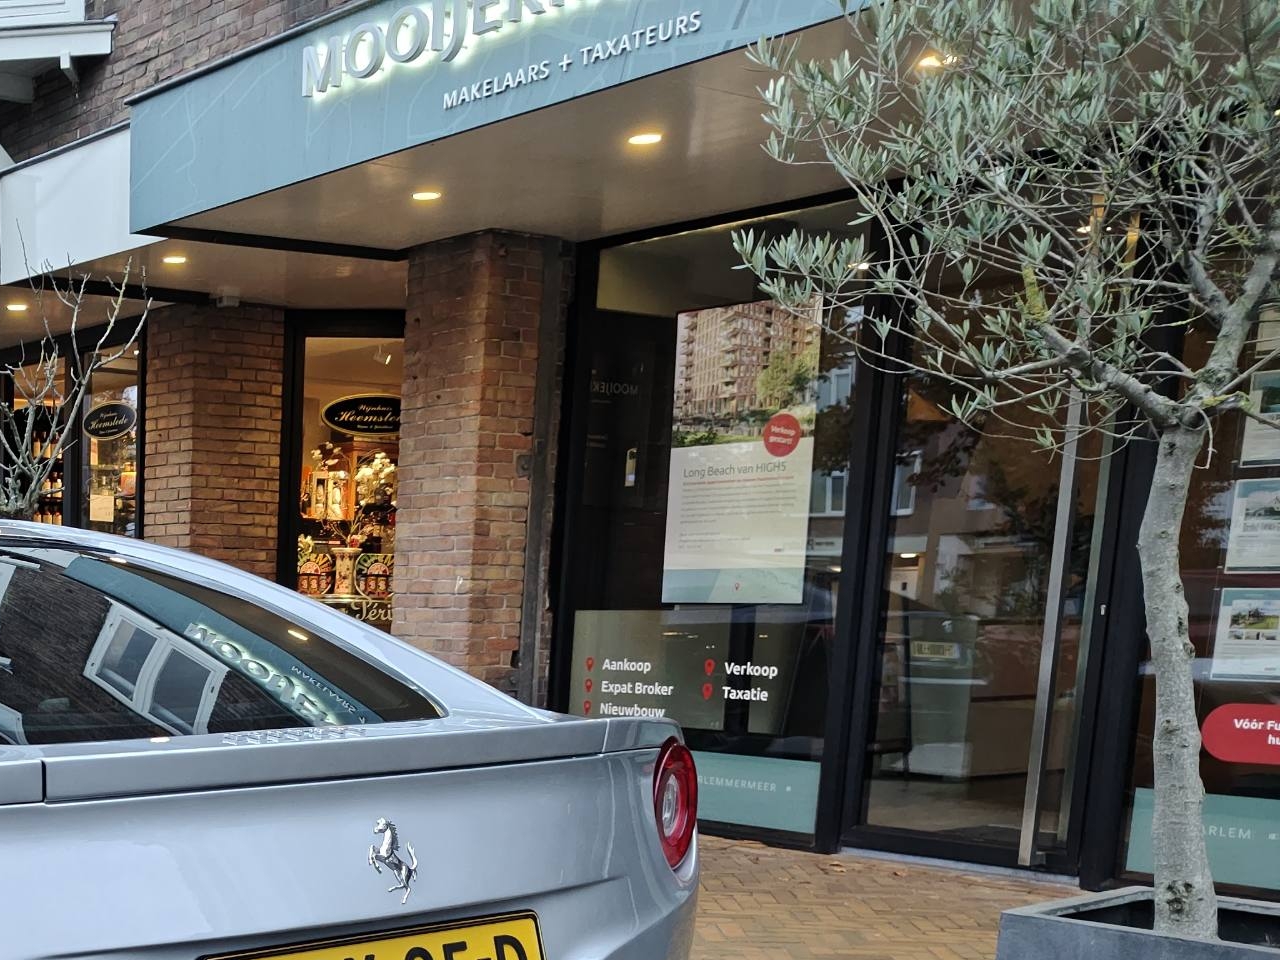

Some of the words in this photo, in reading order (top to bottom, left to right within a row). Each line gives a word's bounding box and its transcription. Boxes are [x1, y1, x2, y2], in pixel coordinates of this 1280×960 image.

[301, 0, 566, 97] MOOIJE
[442, 60, 550, 110] MAKELAARS
[558, 54, 574, 73] +
[579, 11, 703, 66] TAXATEURS
[683, 468, 706, 480] Long
[707, 464, 736, 477] Beach
[737, 466, 754, 475] van
[602, 658, 651, 673] Aankoop
[724, 662, 778, 679] Verkoop
[601, 680, 632, 695] Expat
[635, 682, 674, 696] Broker
[722, 686, 768, 702] Taxatie
[600, 703, 665, 717] Nieuwbouw
[1233, 718, 1264, 730] Vóór
